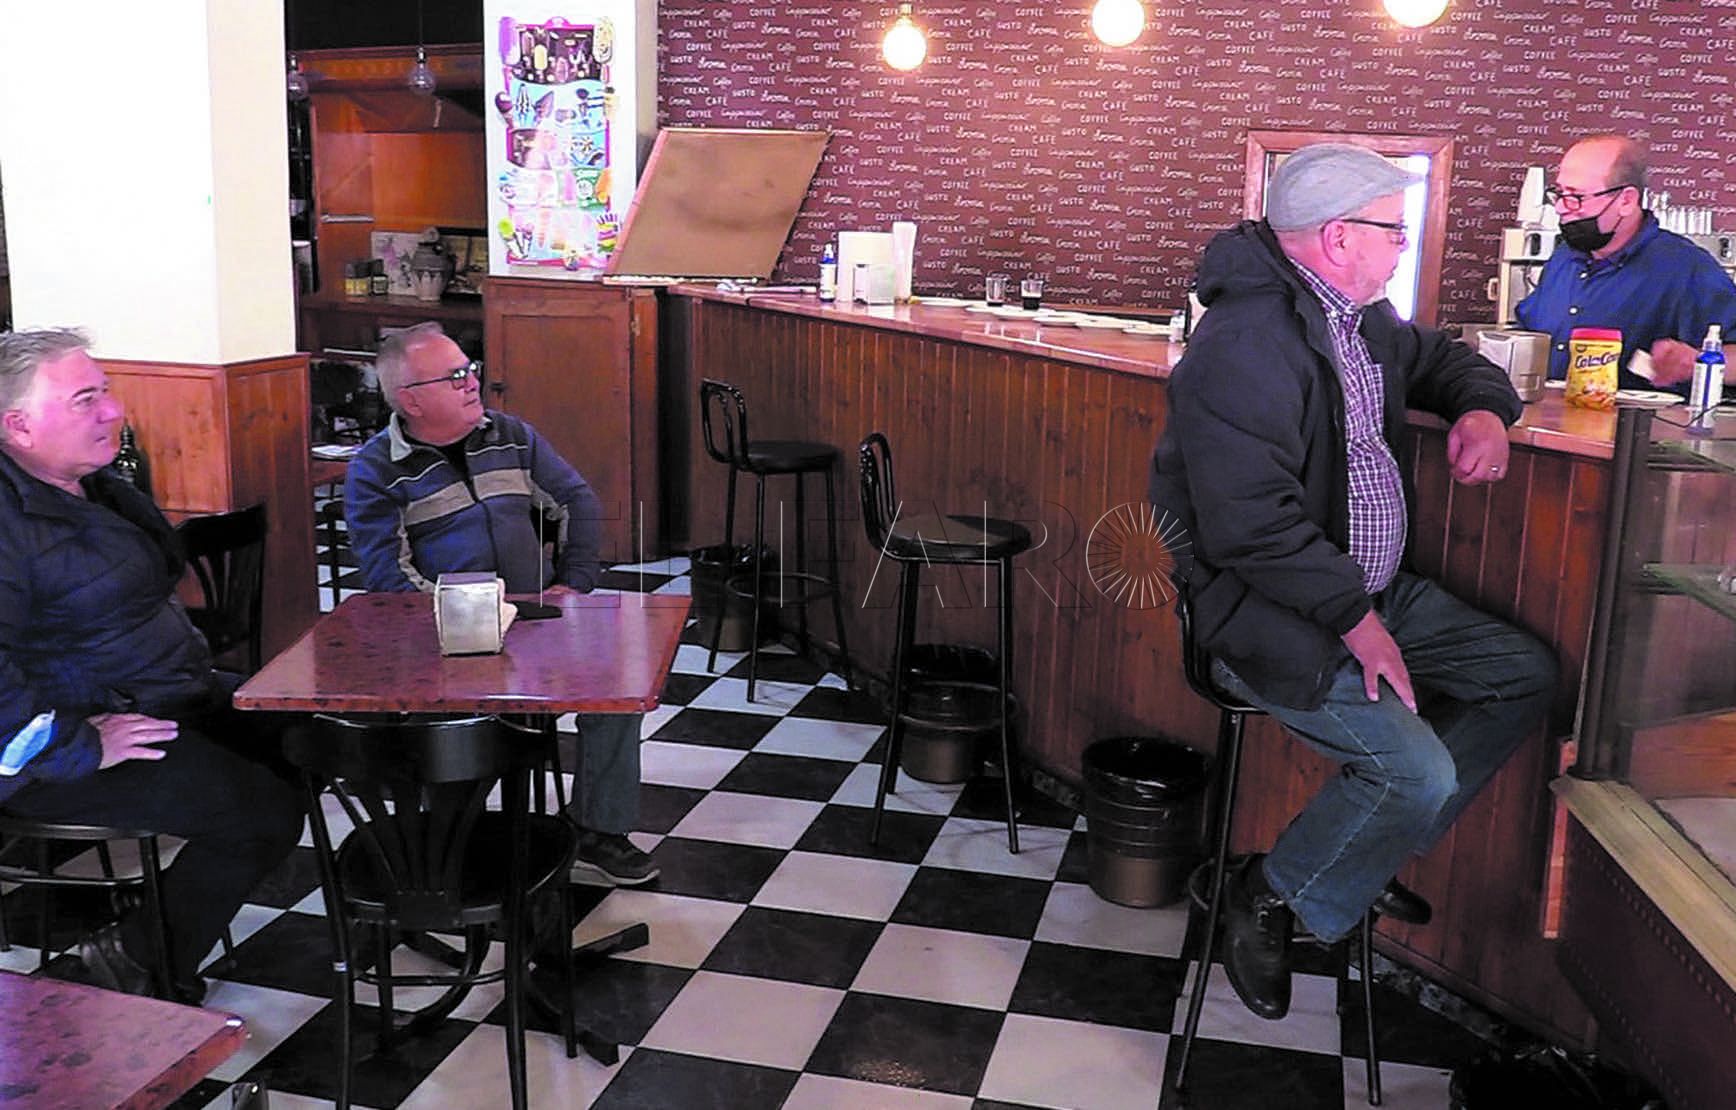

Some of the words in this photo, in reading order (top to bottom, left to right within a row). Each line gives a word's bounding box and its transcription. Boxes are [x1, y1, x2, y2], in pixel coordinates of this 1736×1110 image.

[749, 8, 776, 16] COFFEE
[1015, 7, 1044, 16] COFFEE
[1155, 8, 1185, 16] COFFEE
[1300, 10, 1331, 18] COFFEE
[1450, 11, 1482, 20] COFFEE
[811, 18, 838, 26] CREAM
[943, 18, 972, 26] CREAM
[1604, 14, 1638, 23] COFFEE
[683, 19, 710, 27] CREAM
[1223, 20, 1254, 28] CREAM
[1429, 26, 1457, 34] GUSTO
[1522, 24, 1556, 33] CREAM
[1582, 28, 1612, 36] GUSTO
[1679, 27, 1713, 36] CREAM
[686, 43, 712, 51] COFFEE
[813, 42, 840, 50] COFFEE
[945, 42, 973, 51] COFFEE
[1225, 45, 1255, 53] COFFEE
[1372, 47, 1403, 56] COFFEE
[1523, 50, 1556, 59] COFFEE
[746, 52, 773, 60] CREAM
[796, 55, 820, 63] GUSTO
[1010, 53, 1039, 62] CREAM
[1150, 55, 1180, 63] CREAM
[1679, 54, 1713, 63] COFFEE
[1064, 57, 1089, 65] GUSTO
[1205, 59, 1232, 67] GUSTO
[1294, 57, 1325, 65] CREAM
[1351, 61, 1379, 69] GUSTO
[1443, 60, 1476, 68] CREAM
[1502, 64, 1530, 72] GUSTO
[1596, 63, 1630, 72] CREAM
[1657, 68, 1686, 76] GUSTO
[748, 76, 775, 84] COFFEE
[878, 77, 905, 85] COFFEE
[1012, 78, 1040, 87] COFFEE
[1152, 80, 1181, 88] COFFEE
[683, 86, 709, 94] CREAM
[810, 86, 837, 95] CREAM
[1295, 82, 1326, 91] COFFEE
[1444, 86, 1476, 95] COFFEE
[941, 87, 970, 96] CREAM
[1078, 90, 1107, 98] CREAM
[1597, 90, 1630, 99] COFFEE
[1219, 92, 1250, 100] CREAM
[1275, 96, 1302, 104] GUSTO
[1365, 95, 1397, 104] CREAM
[1423, 99, 1451, 107] GUSTO
[1516, 98, 1549, 107] CREAM
[1575, 103, 1604, 112] GUSTO
[1671, 103, 1705, 112] CREAM
[685, 109, 711, 117] COFFEE
[812, 110, 839, 119] COFFEE
[943, 112, 971, 120] COFFEE
[1080, 114, 1109, 123] COFFEE
[1221, 117, 1251, 125] COFFEE
[746, 119, 772, 127] CREAM
[874, 121, 902, 129] CREAM
[1366, 120, 1397, 129] COFFEE
[925, 125, 950, 133] GUSTO
[1008, 123, 1037, 132] CREAM
[1147, 126, 1176, 135] CREAM
[1516, 125, 1549, 134] COFFEE
[1202, 130, 1228, 138] GUSTO
[1671, 129, 1704, 138] COFFEE
[1495, 138, 1523, 146] GUSTO
[876, 145, 904, 153] COFFEE
[1649, 143, 1678, 151] GUSTO
[1010, 148, 1038, 156] COFFEE
[1148, 151, 1178, 160] COFFEE
[859, 158, 883, 166] GUSTO
[939, 156, 968, 165] CREAM
[1075, 160, 1104, 168] CREAM
[992, 161, 1016, 169] GUSTO
[1129, 164, 1155, 172] GUSTO
[942, 180, 969, 189] COFFEE
[1662, 178, 1696, 187] CREAM
[1077, 184, 1106, 193] COFFEE
[873, 189, 901, 197] CREAM
[924, 193, 948, 201] GUSTO
[1006, 192, 1034, 201] CREAM
[1058, 197, 1084, 205] GUSTO
[1143, 196, 1173, 205] CREAM
[1198, 201, 1224, 209] GUSTO
[808, 220, 835, 229] CREAM
[1007, 217, 1035, 225] COFFEE
[1145, 221, 1174, 229] COFFEE
[938, 224, 966, 233] CREAM
[989, 229, 1014, 237] GUSTO
[1072, 229, 1101, 238] CREAM
[1126, 234, 1151, 242] GUSTO
[939, 248, 967, 257] COFFEE
[793, 256, 816, 264] GUSTO
[1074, 253, 1102, 262] COFFEE
[1003, 261, 1031, 269] CREAM
[1140, 265, 1169, 274] CREAM
[1141, 290, 1170, 299] COFFEE
